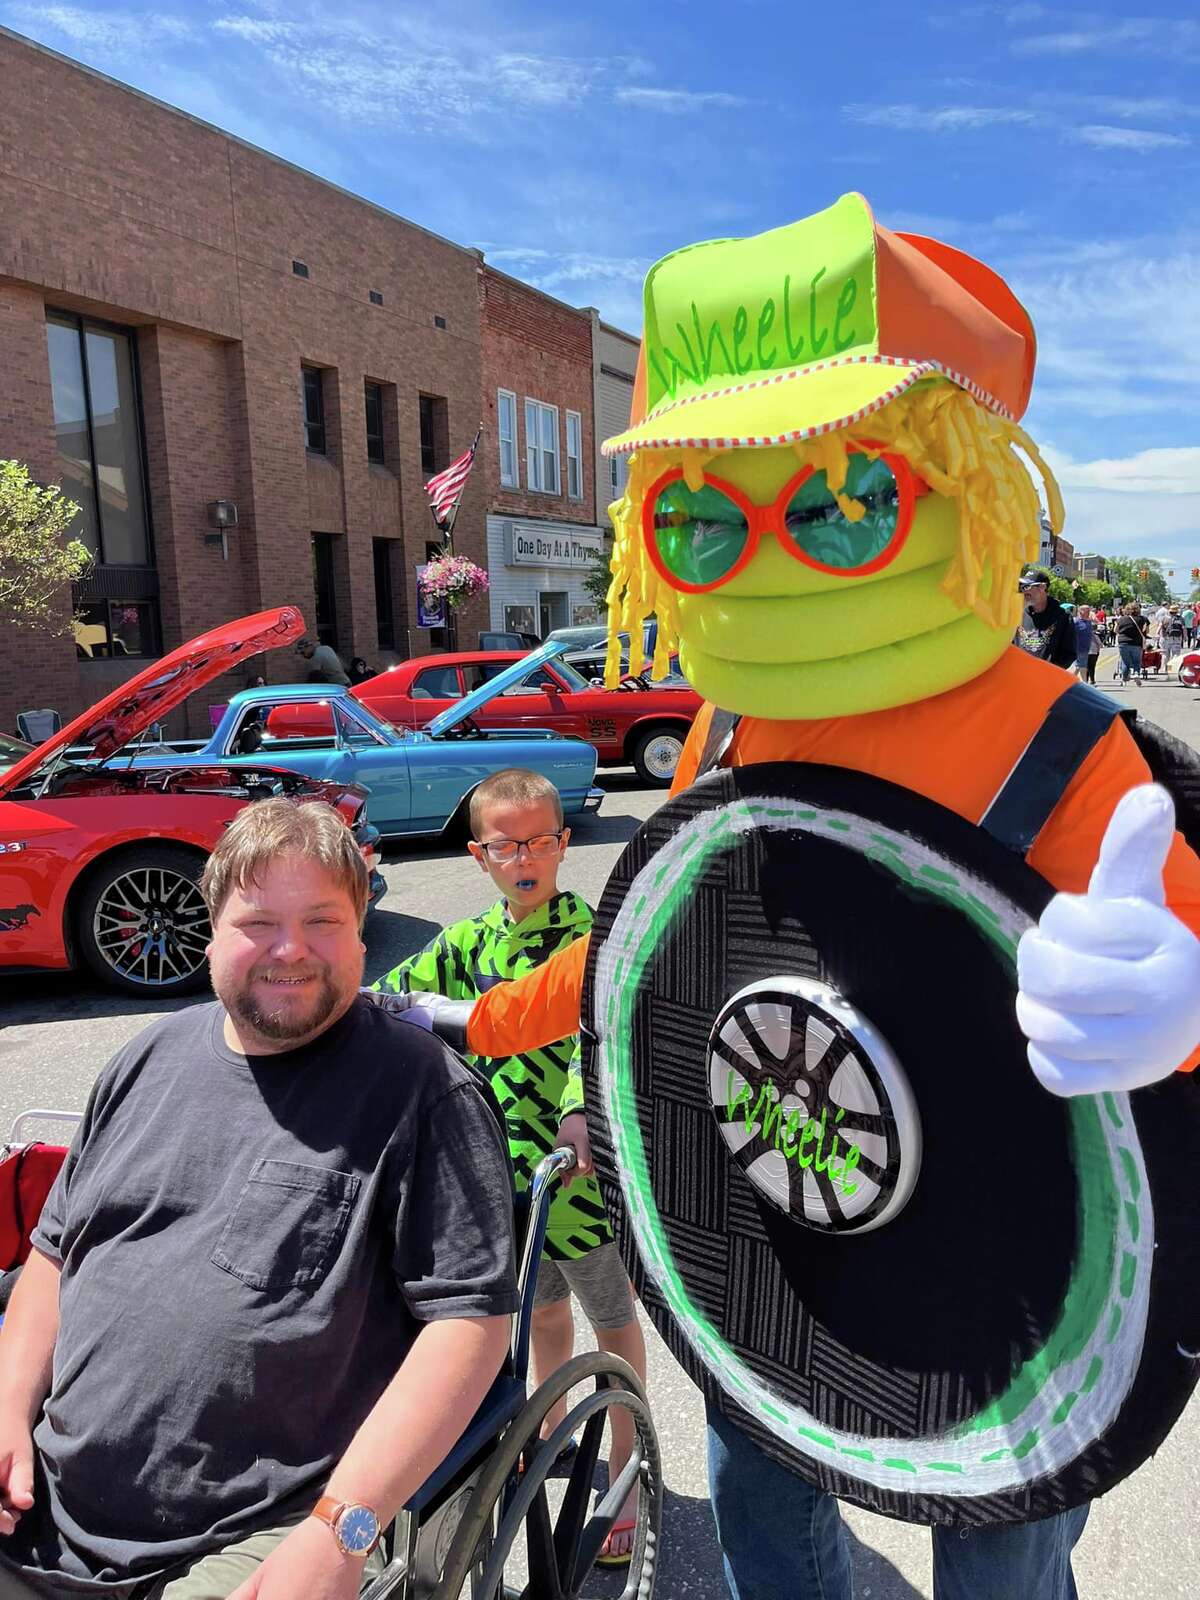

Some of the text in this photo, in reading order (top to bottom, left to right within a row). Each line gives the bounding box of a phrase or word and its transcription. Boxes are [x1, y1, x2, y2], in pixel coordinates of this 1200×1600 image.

[517, 536, 534, 554] One
[536, 539, 552, 560] Day
[554, 540, 562, 557] At
[564, 541, 570, 558] A
[590, 728, 618, 738] SS
[727, 1070, 861, 1195] Wheelie
